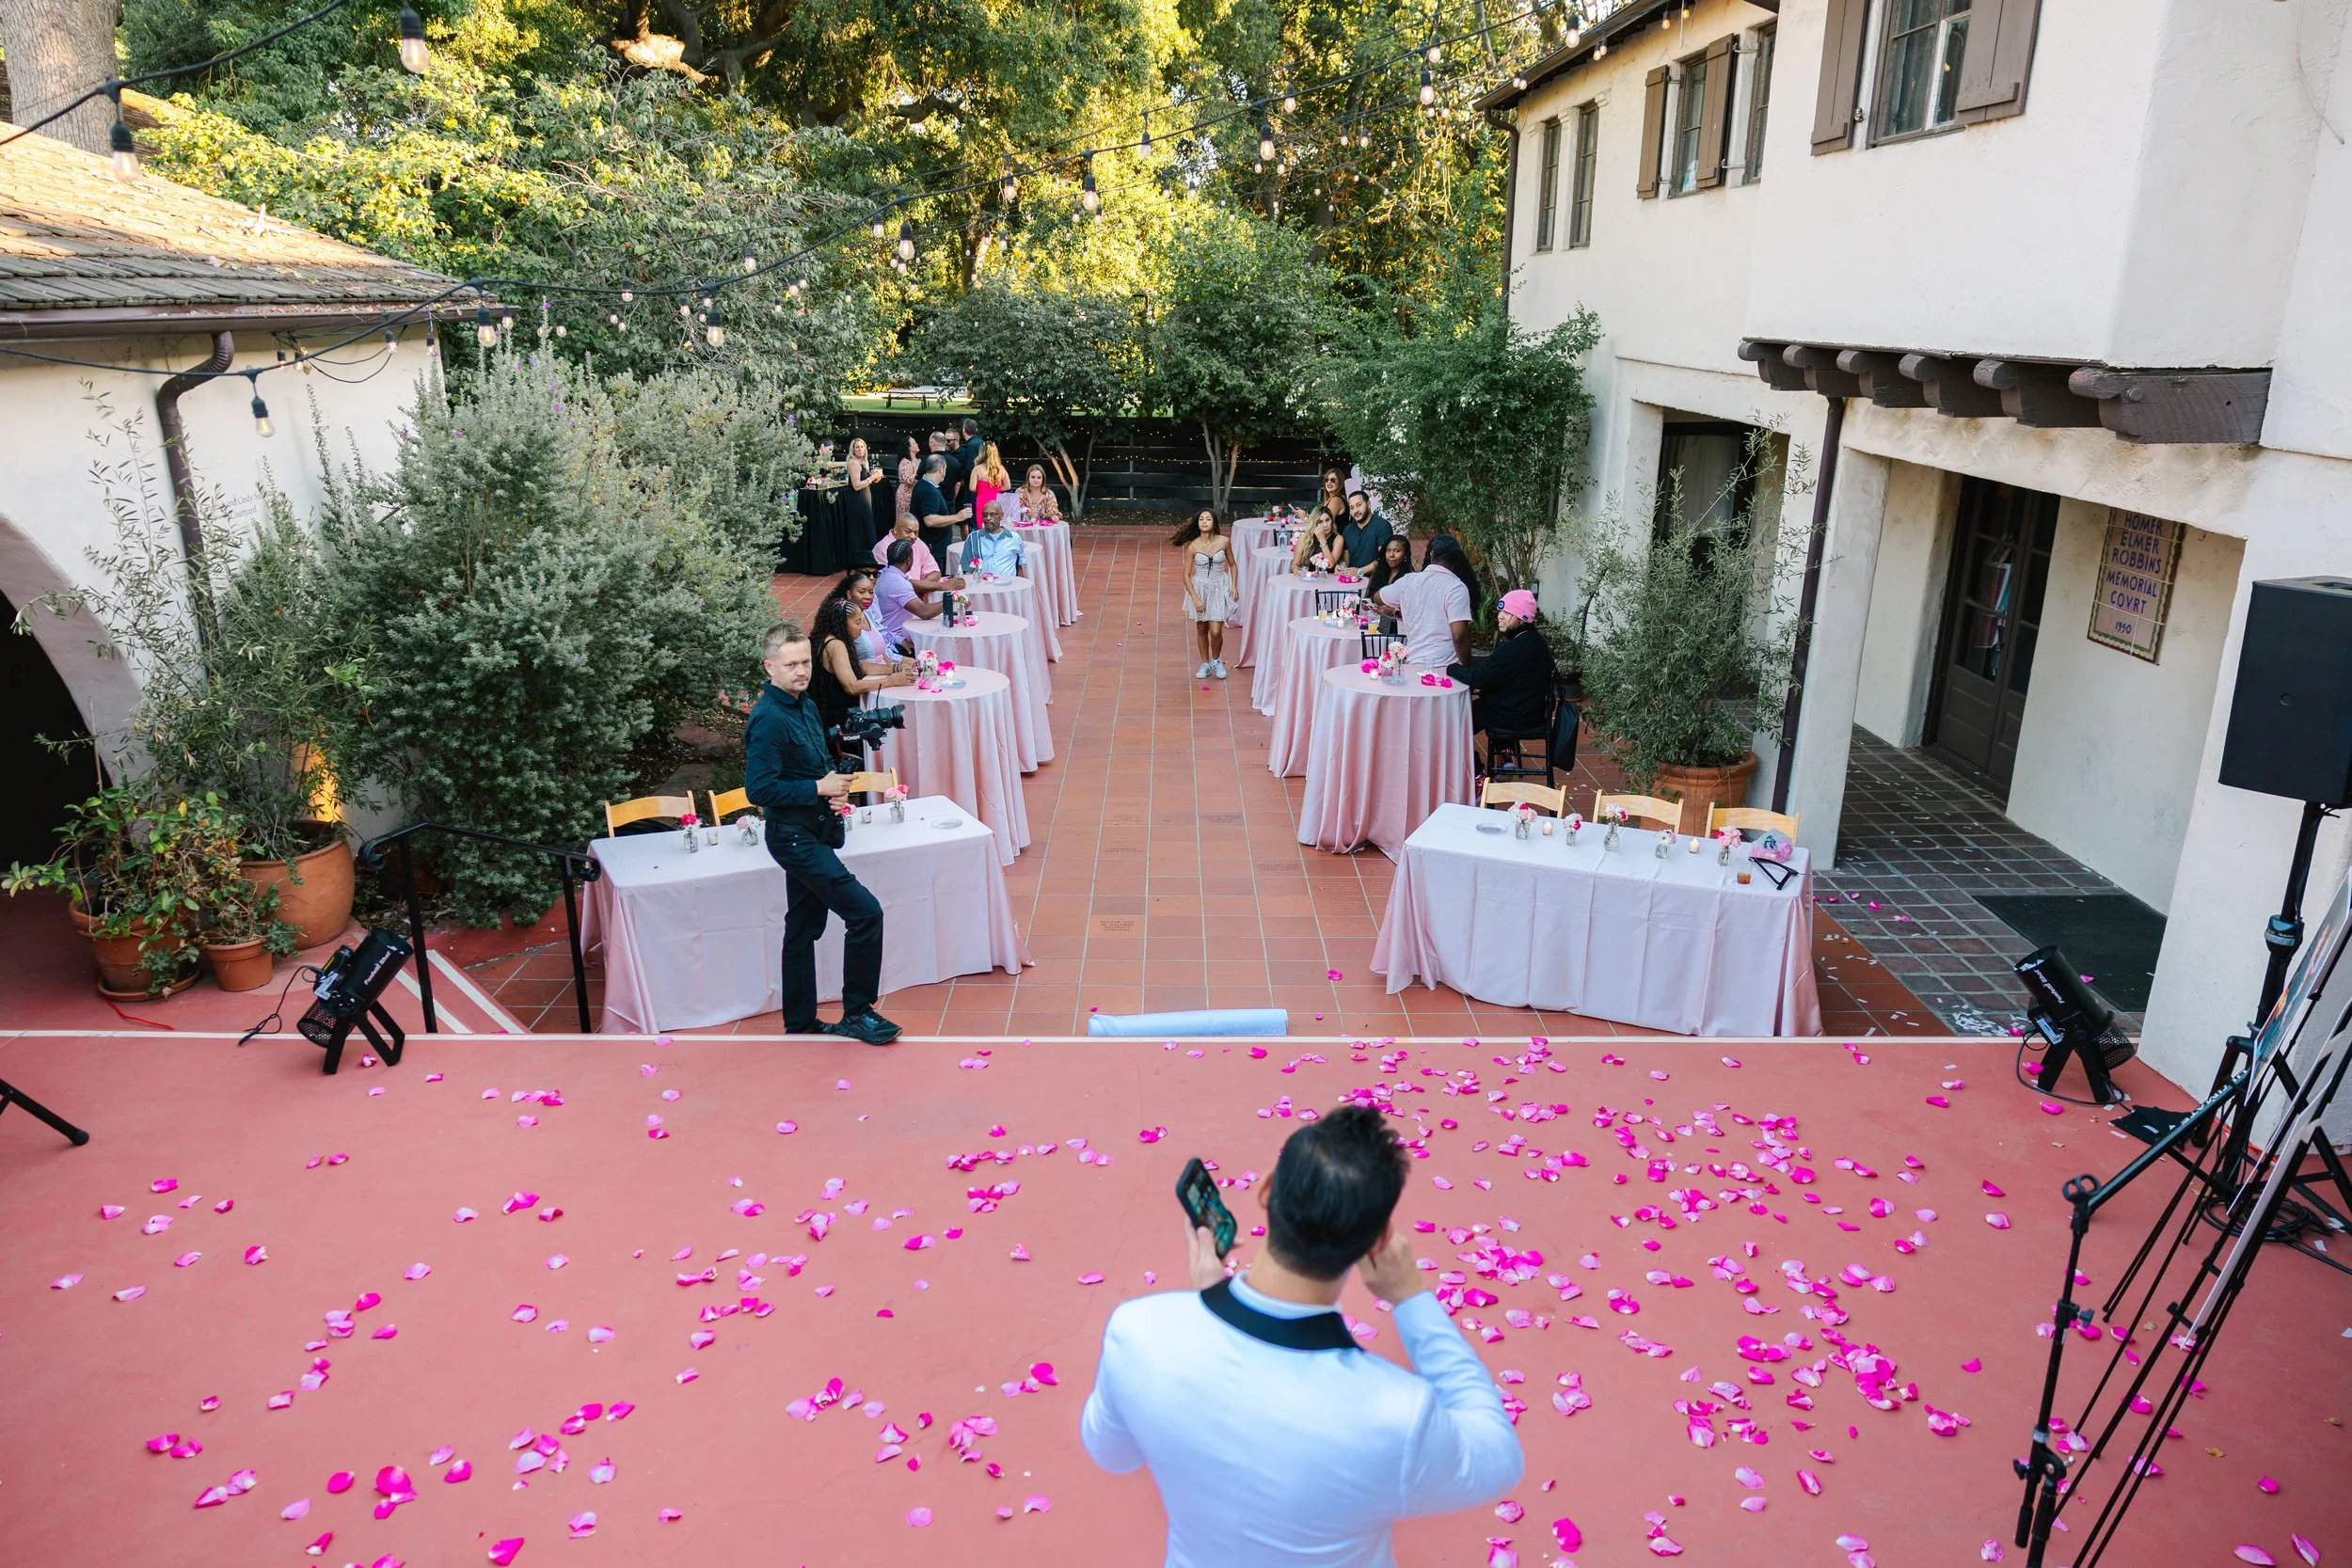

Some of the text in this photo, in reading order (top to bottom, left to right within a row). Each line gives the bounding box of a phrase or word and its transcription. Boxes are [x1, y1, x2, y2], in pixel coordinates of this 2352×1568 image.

[230, 504, 257, 519] Courtyard
[2124, 513, 2163, 535] HOMER
[2120, 531, 2159, 555] ELMER
[2112, 547, 2162, 575] ROBBINS
[2106, 571, 2157, 597] MEMORIAL
[2110, 590, 2147, 614] COVRT
[2115, 621, 2132, 635] 1950
[378, 950, 391, 965] Shot
[2033, 969, 2048, 983] Shot
